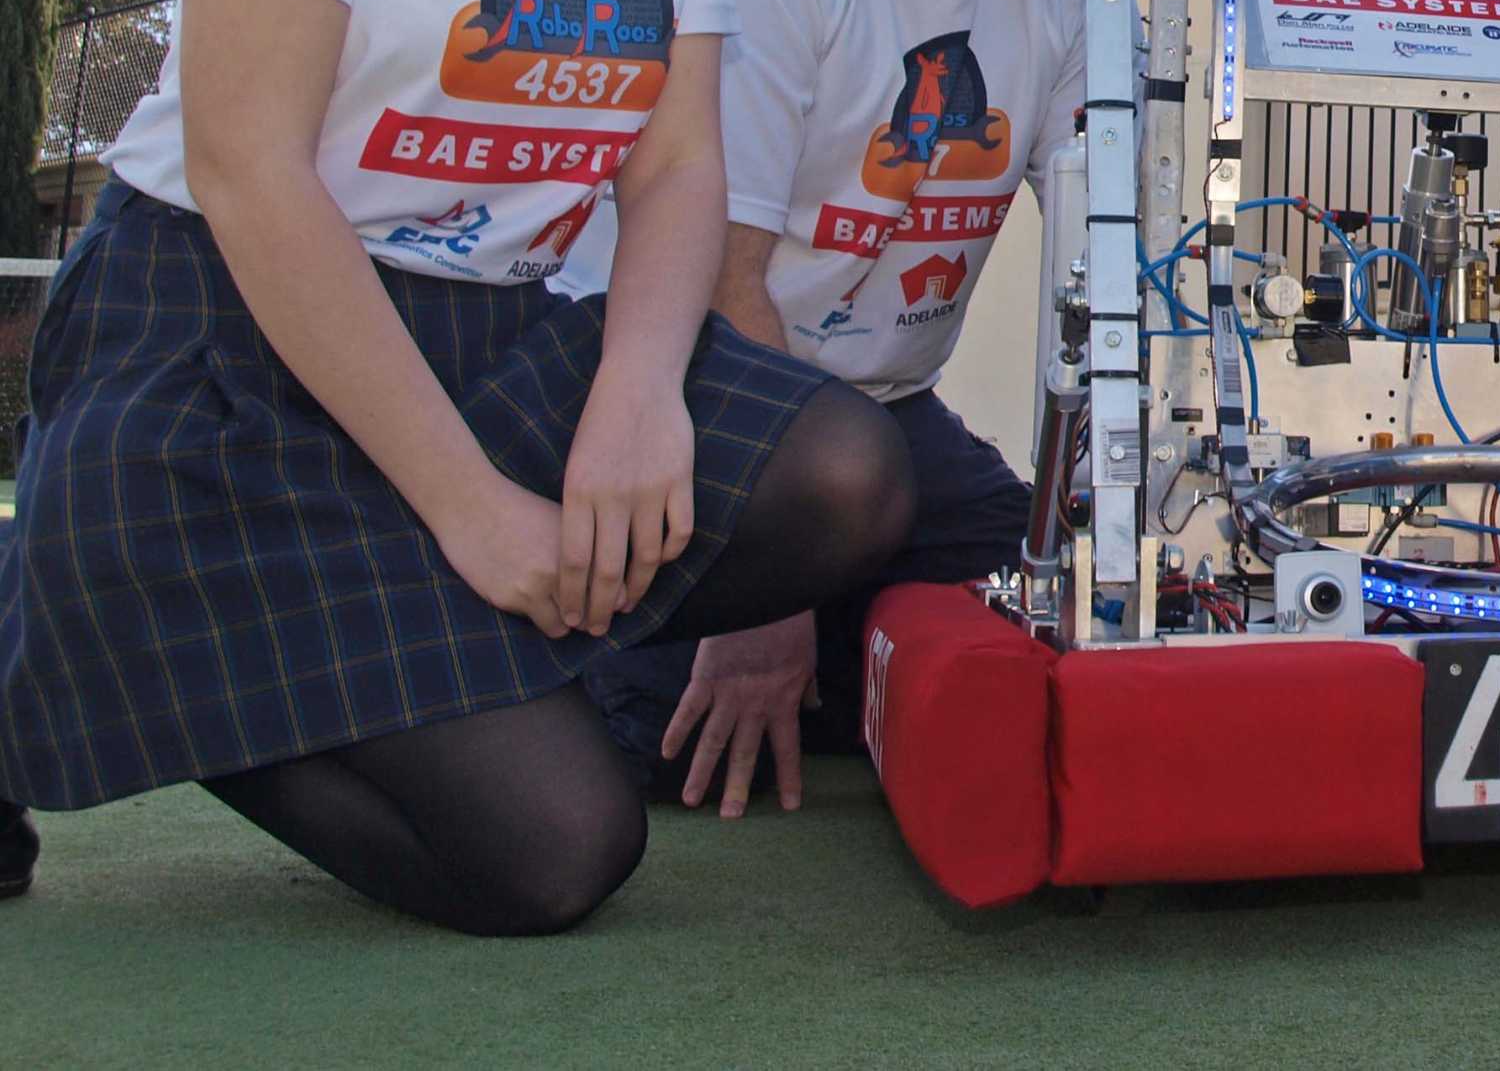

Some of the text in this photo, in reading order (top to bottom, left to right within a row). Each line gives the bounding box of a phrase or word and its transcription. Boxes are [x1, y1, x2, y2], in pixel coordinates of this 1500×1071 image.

[1395, 21, 1472, 34] ADELAIDE
[514, 58, 642, 105] 4537
[391, 129, 636, 172] BAE SYST
[833, 203, 1010, 251] BAE STEMS
[896, 301, 957, 327] ADELAIDE
